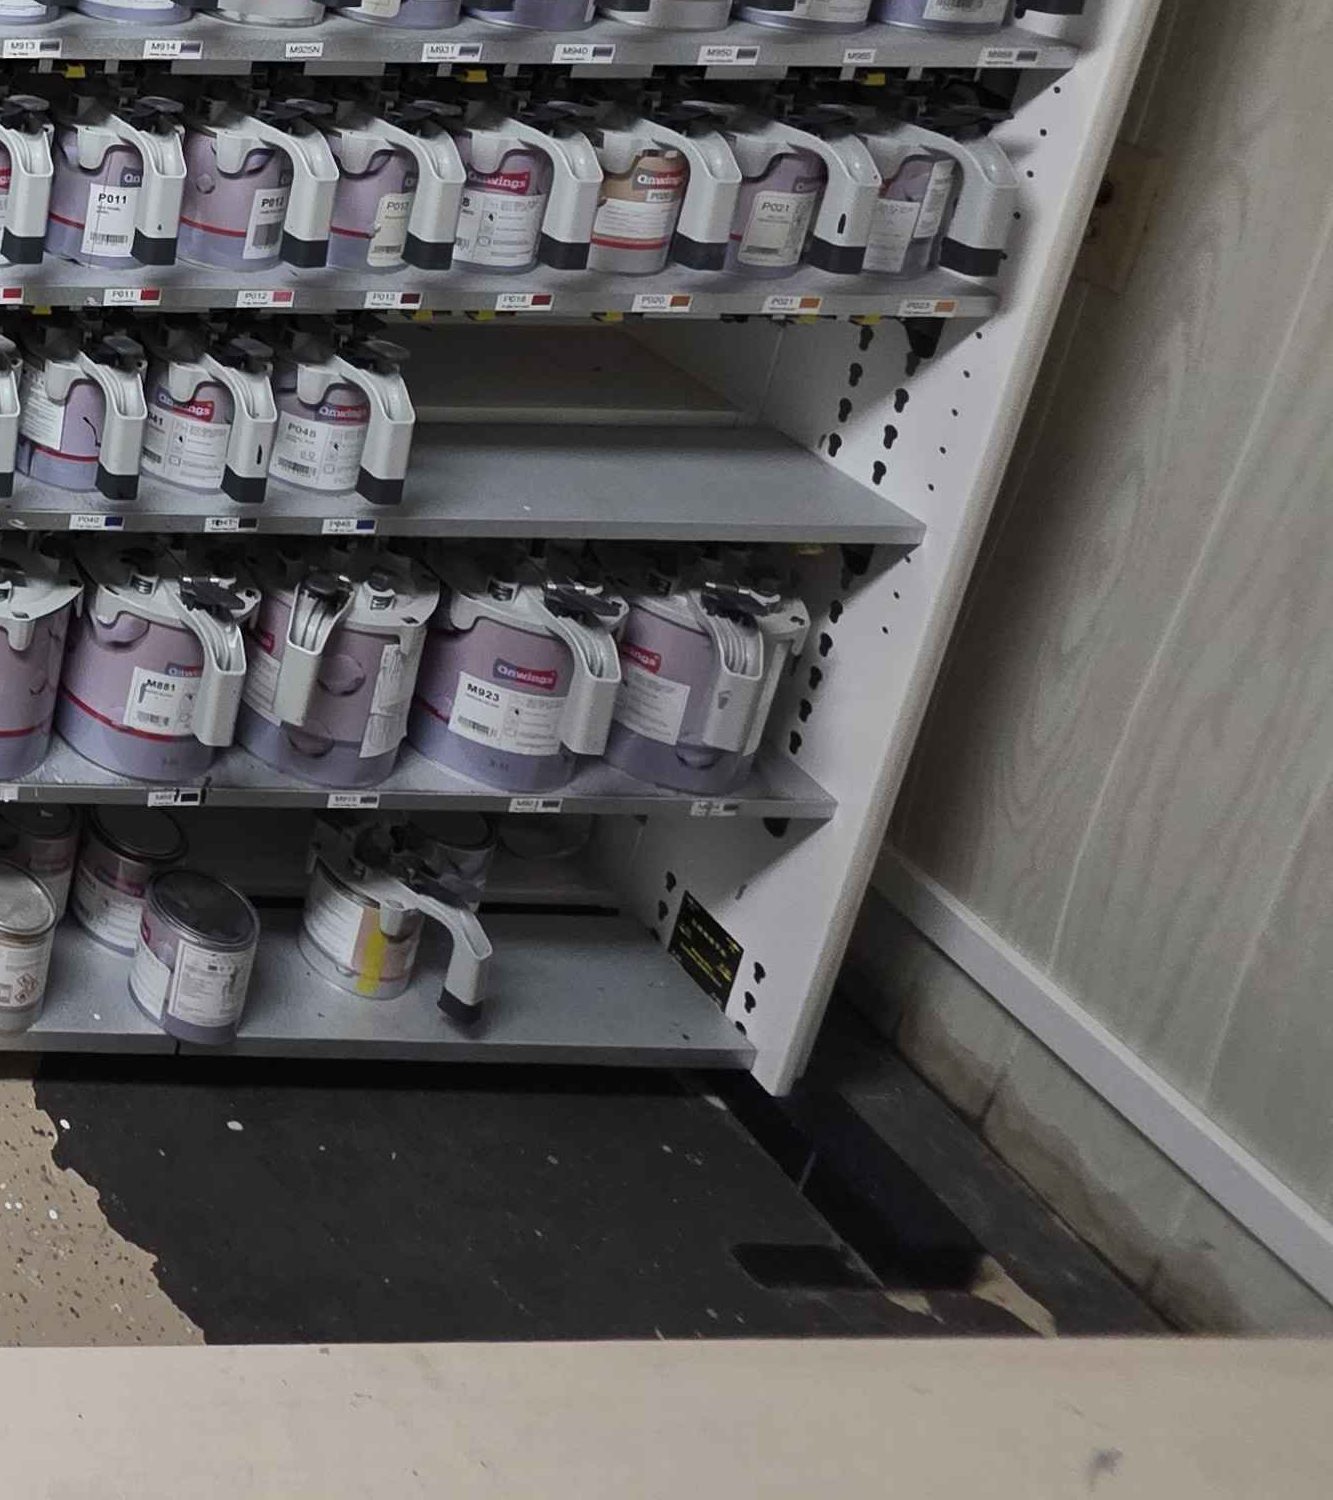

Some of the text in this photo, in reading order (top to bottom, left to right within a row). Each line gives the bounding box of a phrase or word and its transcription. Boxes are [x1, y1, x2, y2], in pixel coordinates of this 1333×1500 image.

[9, 41, 36, 51] M913
[150, 41, 177, 51] M914
[97, 192, 128, 205] P011
[111, 289, 135, 299] P011
[497, 664, 555, 686] Onwings
[466, 683, 500, 702] M923
